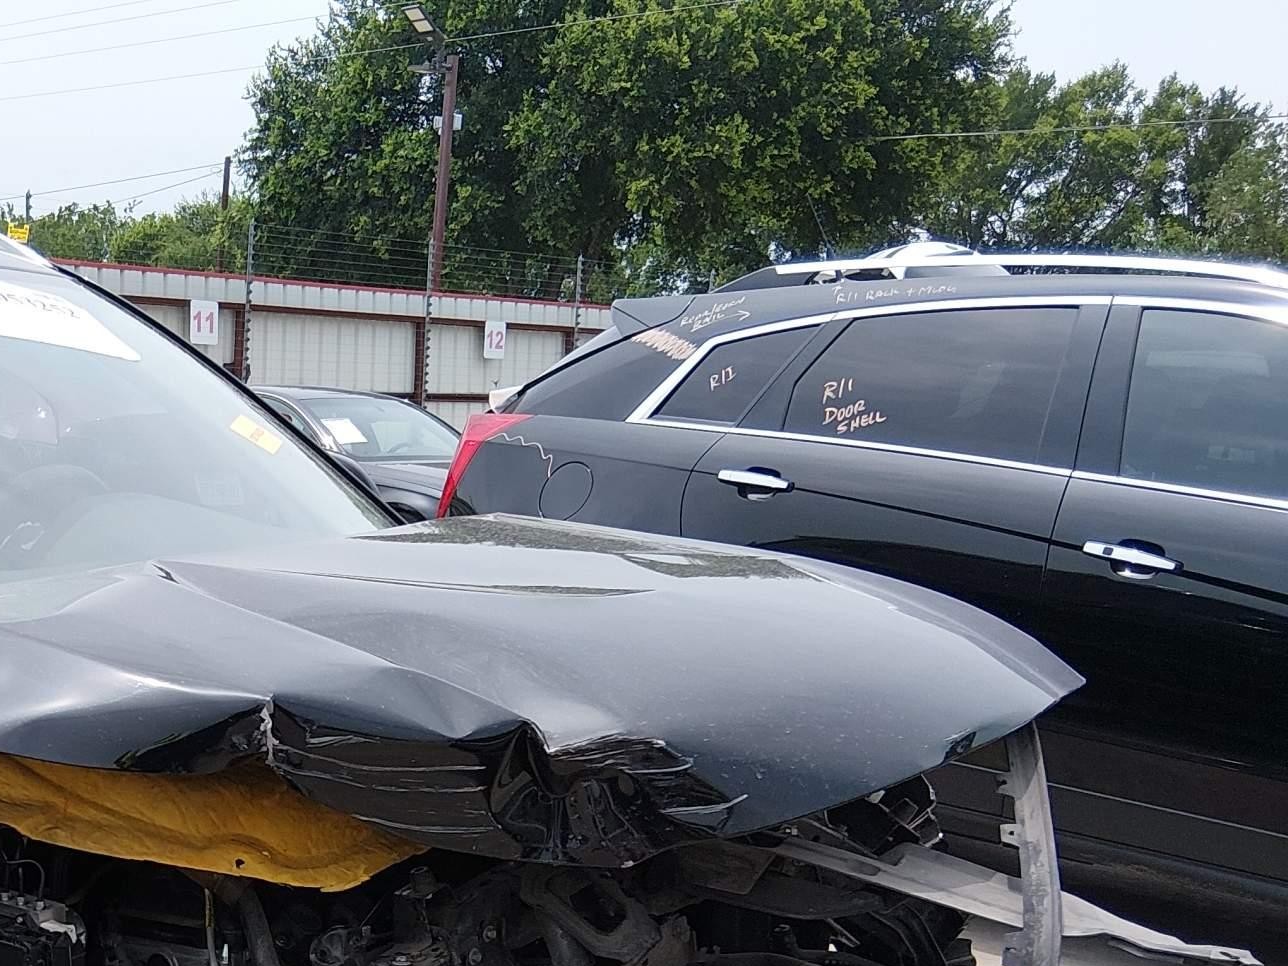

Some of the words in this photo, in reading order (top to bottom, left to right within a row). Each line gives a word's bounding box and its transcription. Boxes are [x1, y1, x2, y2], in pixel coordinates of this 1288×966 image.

[193, 310, 214, 333] 11
[487, 330, 503, 350] 12
[822, 400, 866, 425] DOOR
[837, 411, 887, 435] SHELL
